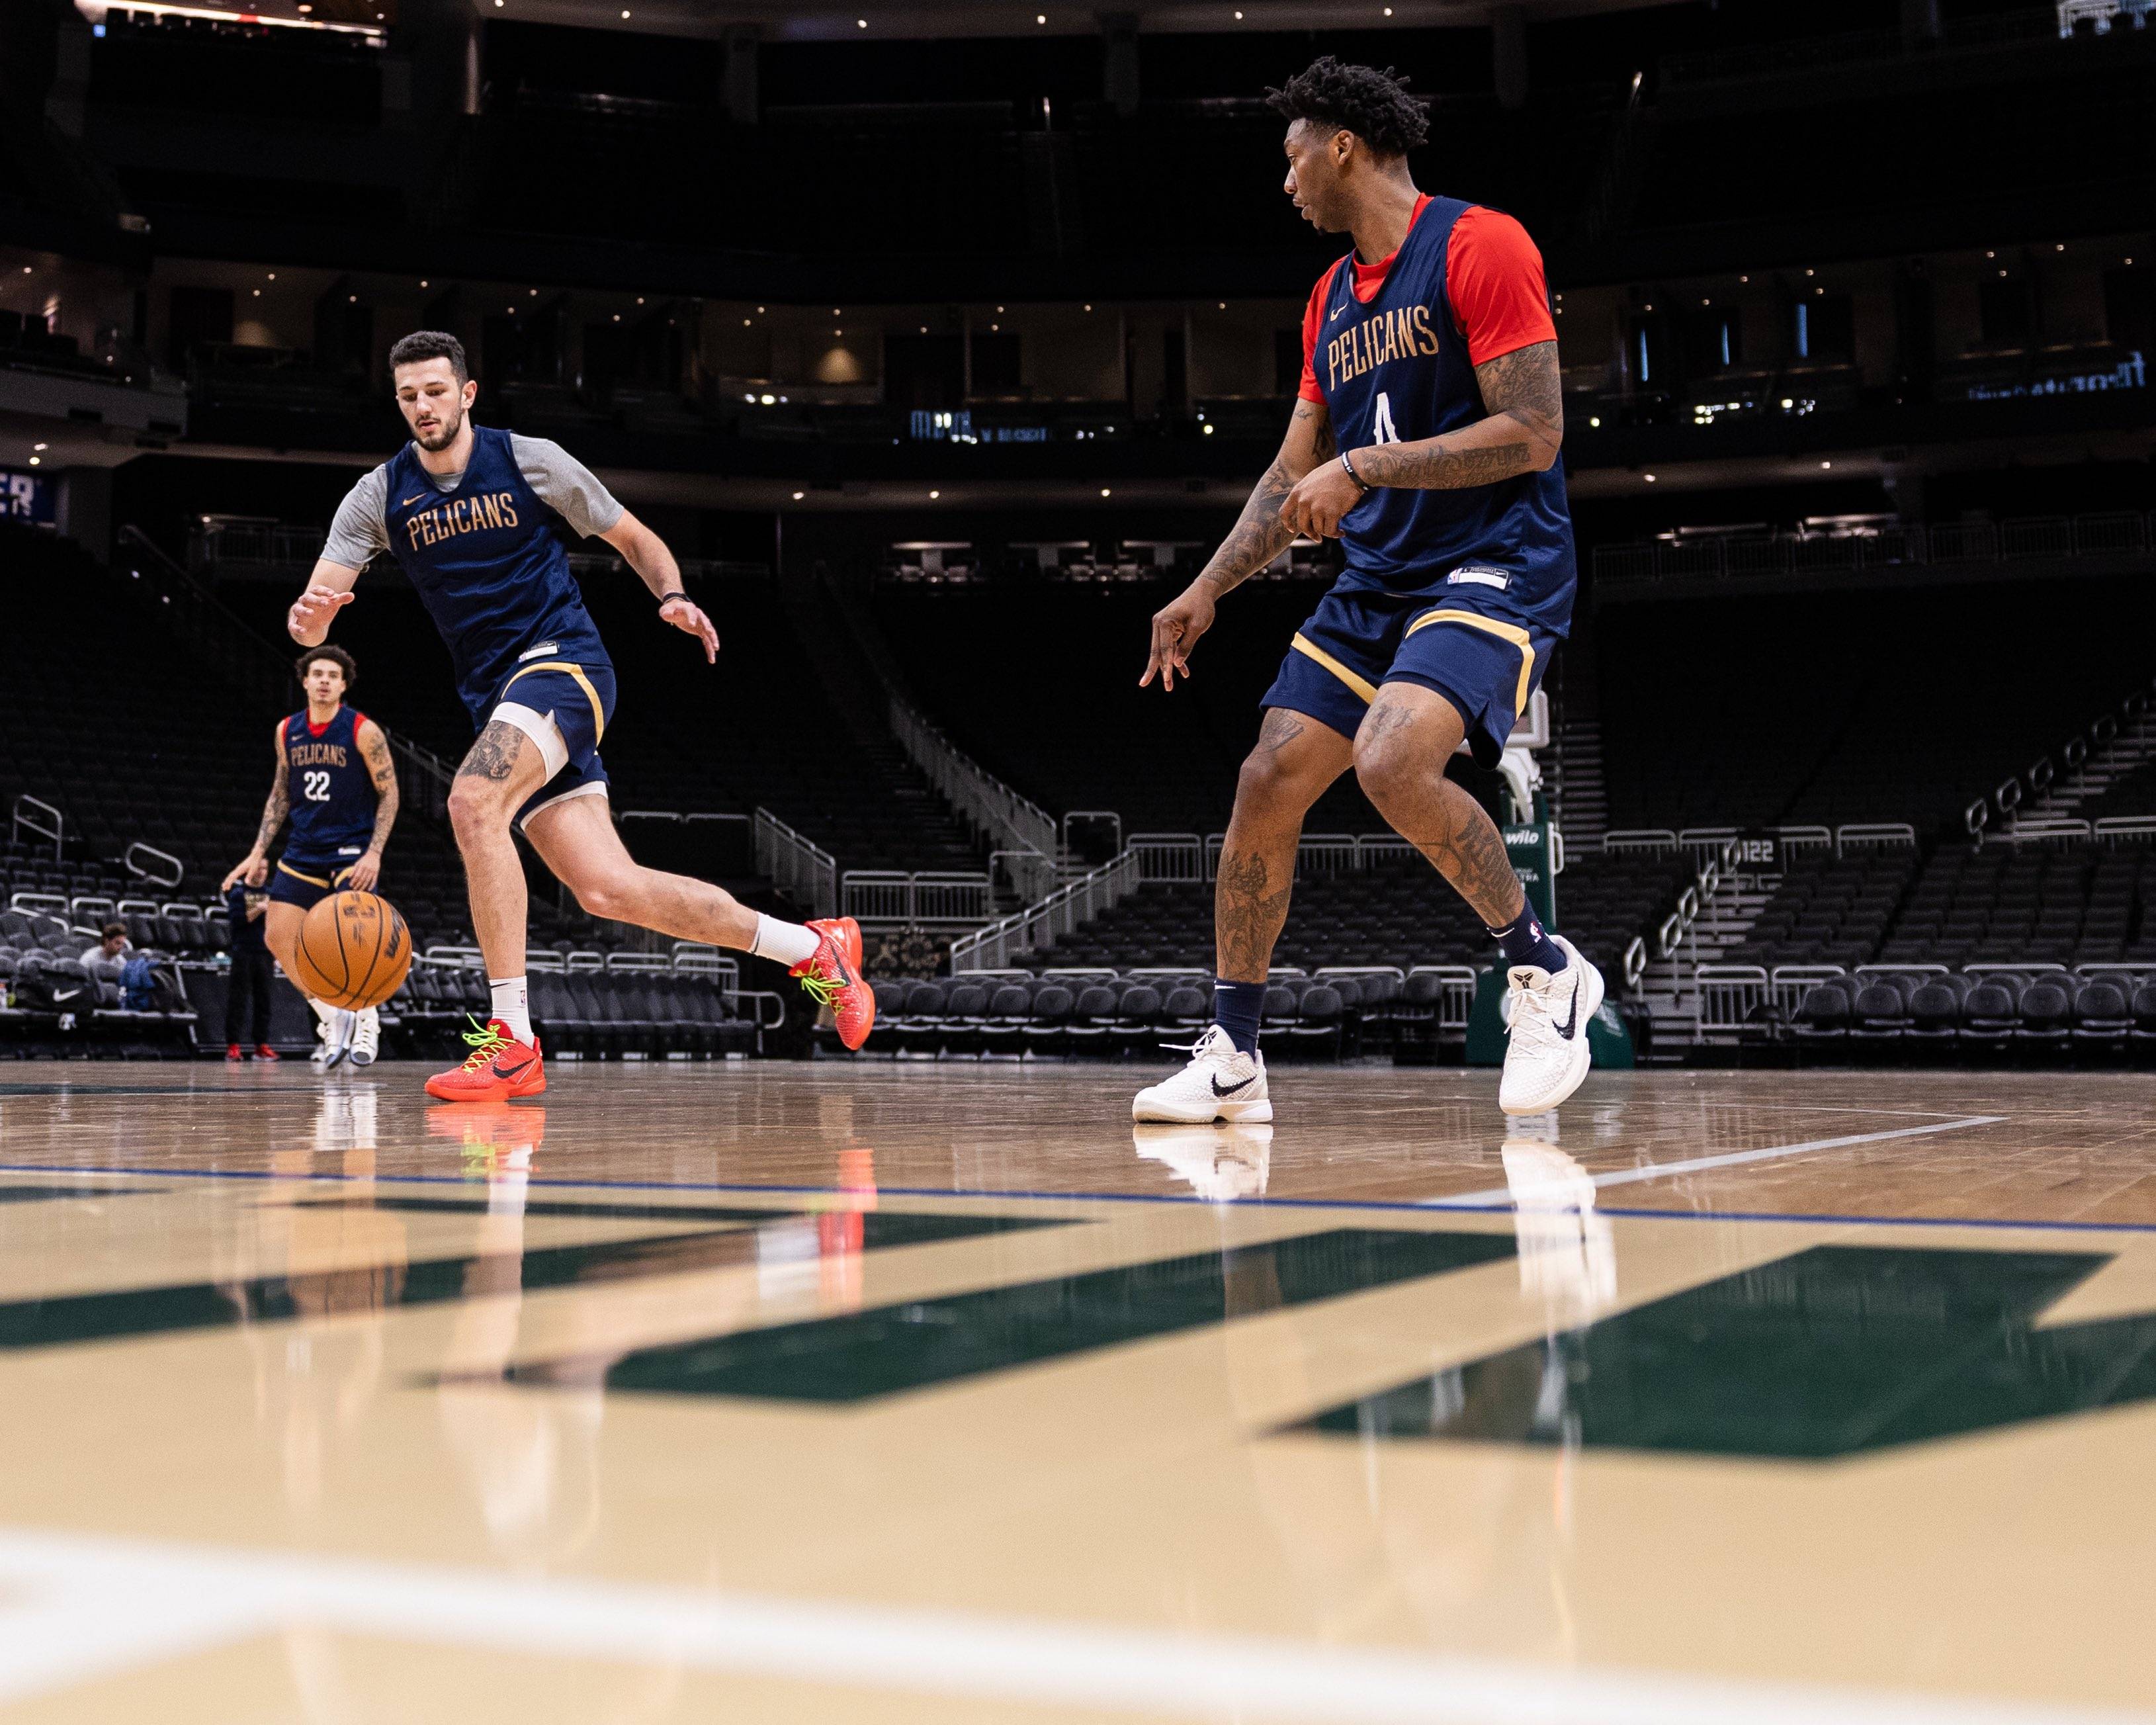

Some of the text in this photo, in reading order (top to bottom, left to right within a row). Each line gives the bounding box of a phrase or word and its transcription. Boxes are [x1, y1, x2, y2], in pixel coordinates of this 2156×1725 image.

[1328, 305, 1439, 392] PELICANS
[406, 493, 519, 551] PELICANS
[291, 744, 347, 768] PELICANS
[304, 771, 330, 801] 22
[1505, 830, 1539, 844] wilo
[1742, 840, 1774, 862] 122
